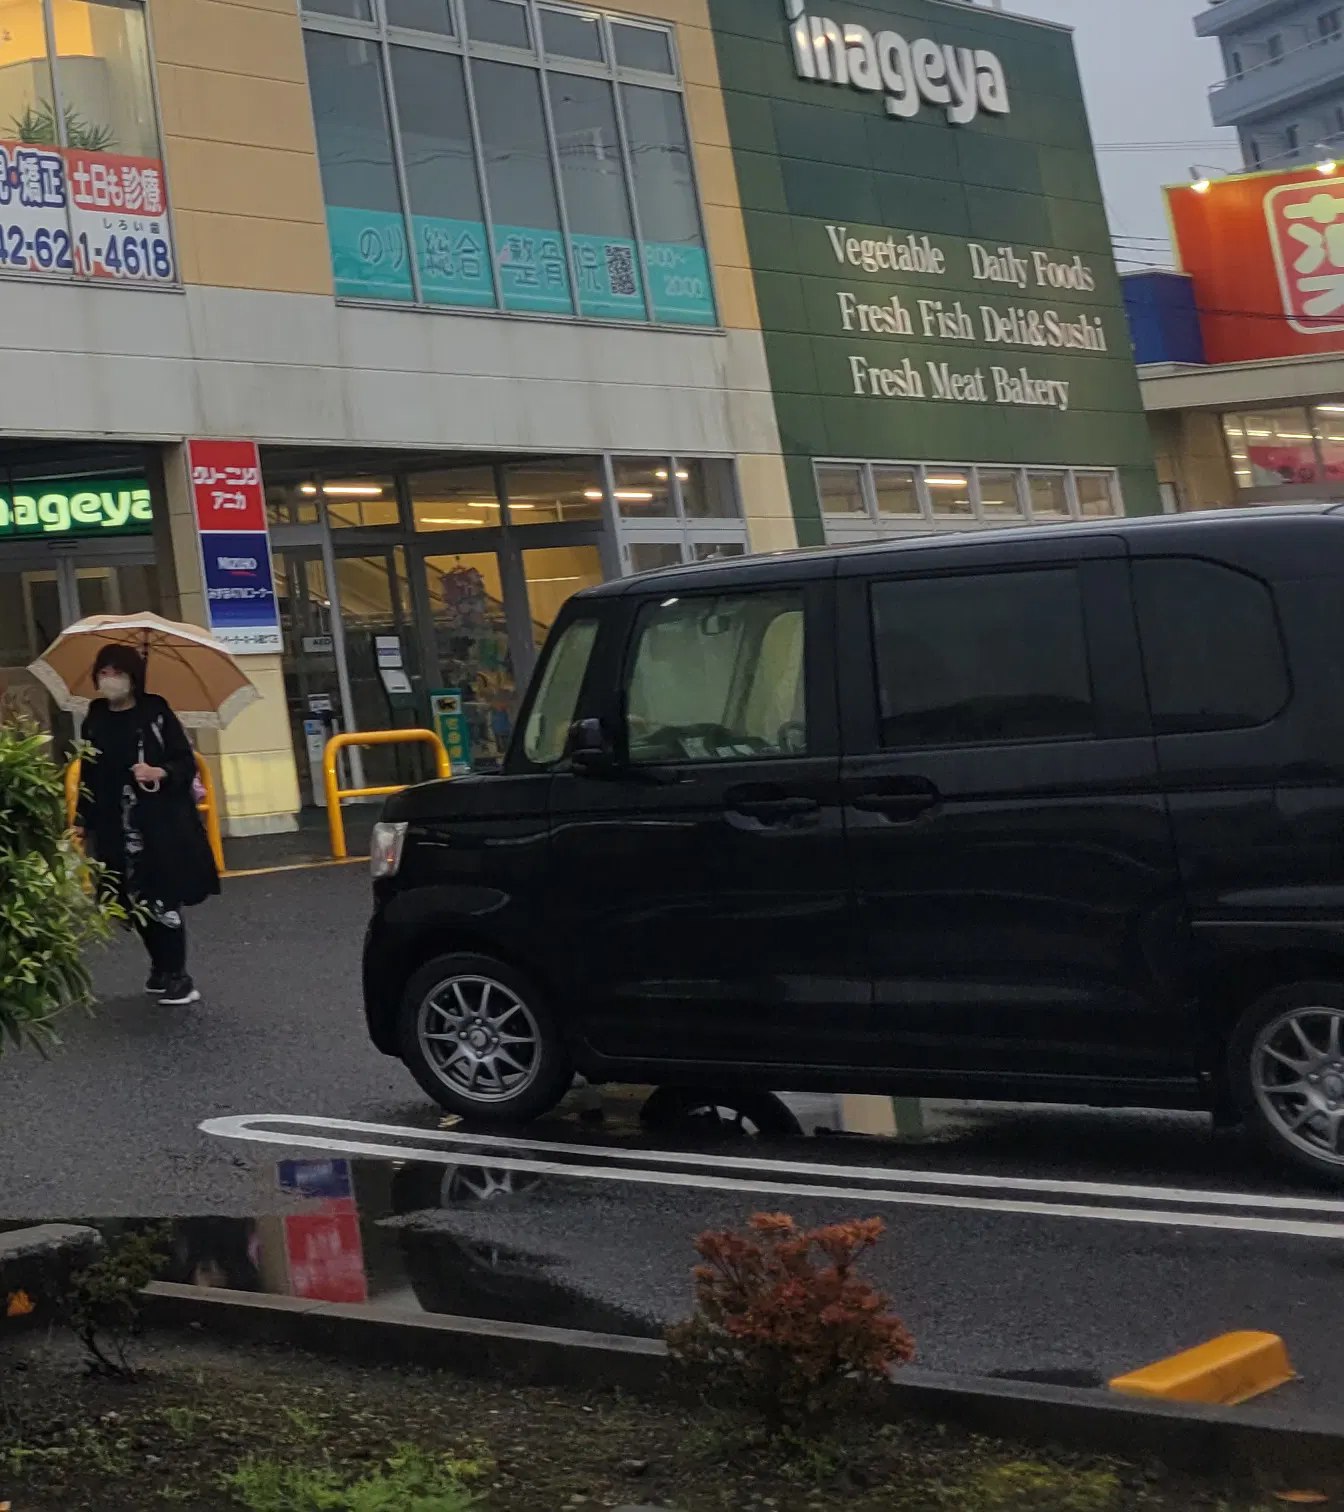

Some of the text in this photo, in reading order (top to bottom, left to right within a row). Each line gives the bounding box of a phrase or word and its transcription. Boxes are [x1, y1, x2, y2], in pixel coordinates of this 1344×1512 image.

[73, 161, 161, 212] 土日も診療
[825, 225, 946, 274] Vegetable
[968, 243, 1095, 291] Daily Foods
[836, 292, 976, 340] Fresh Fish
[848, 356, 988, 402] Fresh Meat
[990, 366, 1069, 410] Bakery
